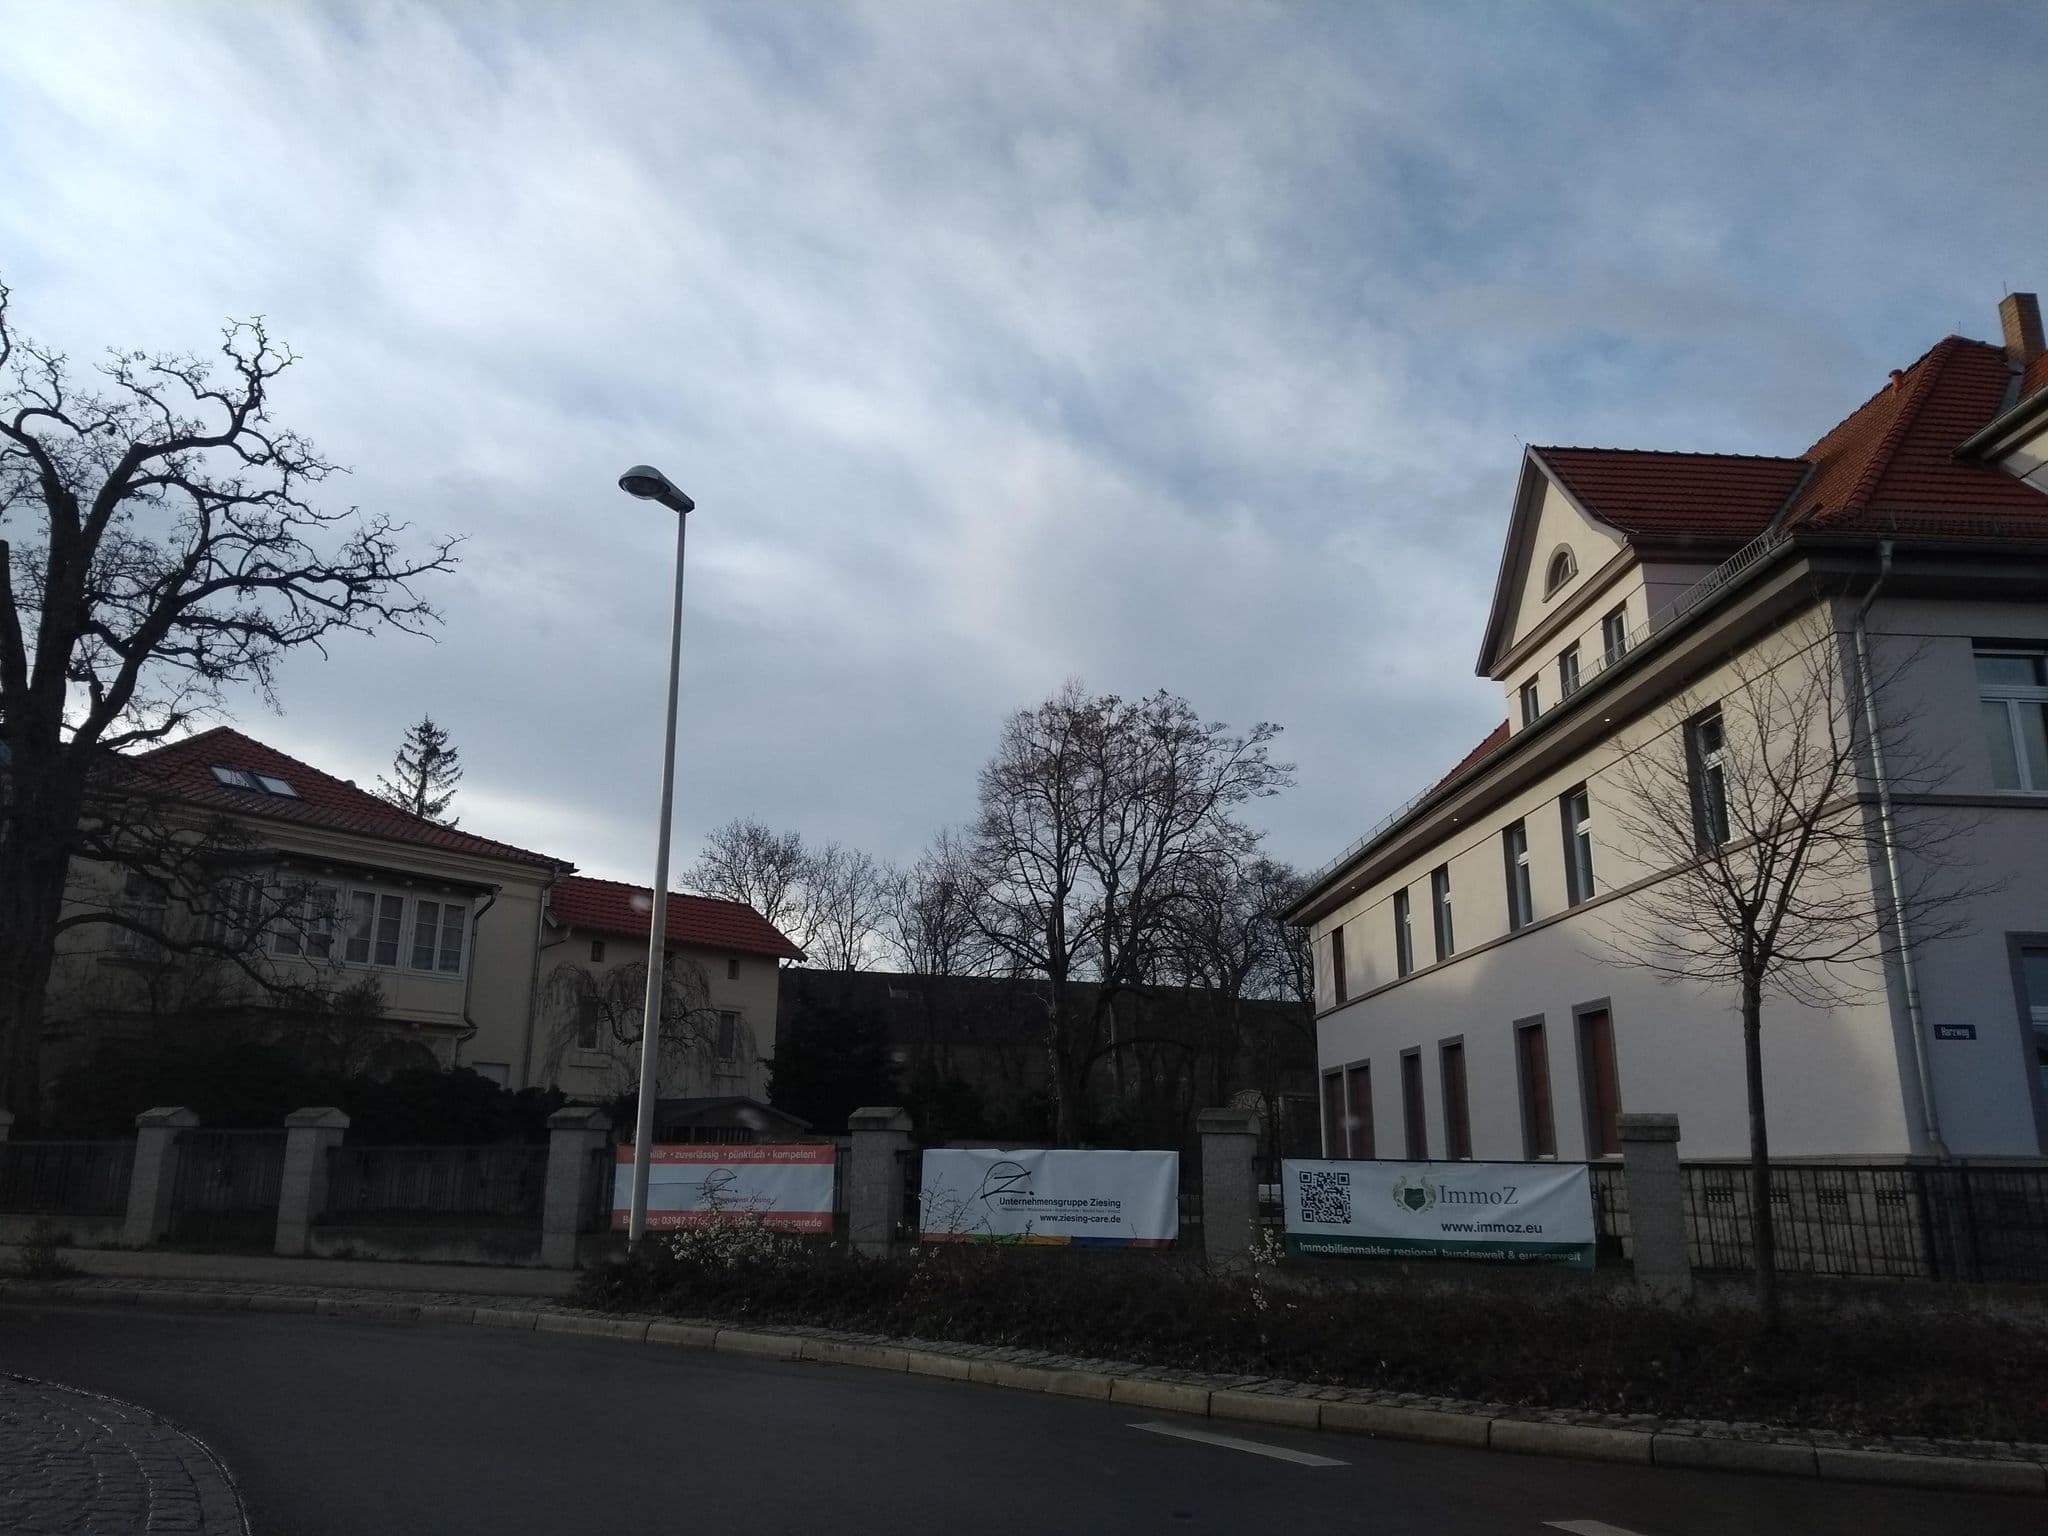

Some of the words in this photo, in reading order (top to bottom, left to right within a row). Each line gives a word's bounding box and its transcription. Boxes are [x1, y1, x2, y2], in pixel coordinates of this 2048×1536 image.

[728, 1150, 765, 1162] pünktlich
[772, 1150, 817, 1163] kompetent
[1439, 1185, 1520, 1206] ImmoZ
[999, 1197, 1088, 1208] Unternehmensgruppe
[1090, 1198, 1121, 1209] Ziesing
[1040, 1214, 1121, 1224] www.ziesing-care.de
[1441, 1221, 1543, 1234] www.immoz.eu
[1299, 1242, 1391, 1255] Immobilienmakler
[1442, 1248, 1505, 1260] bundesweit
[1507, 1250, 1516, 1260] &
